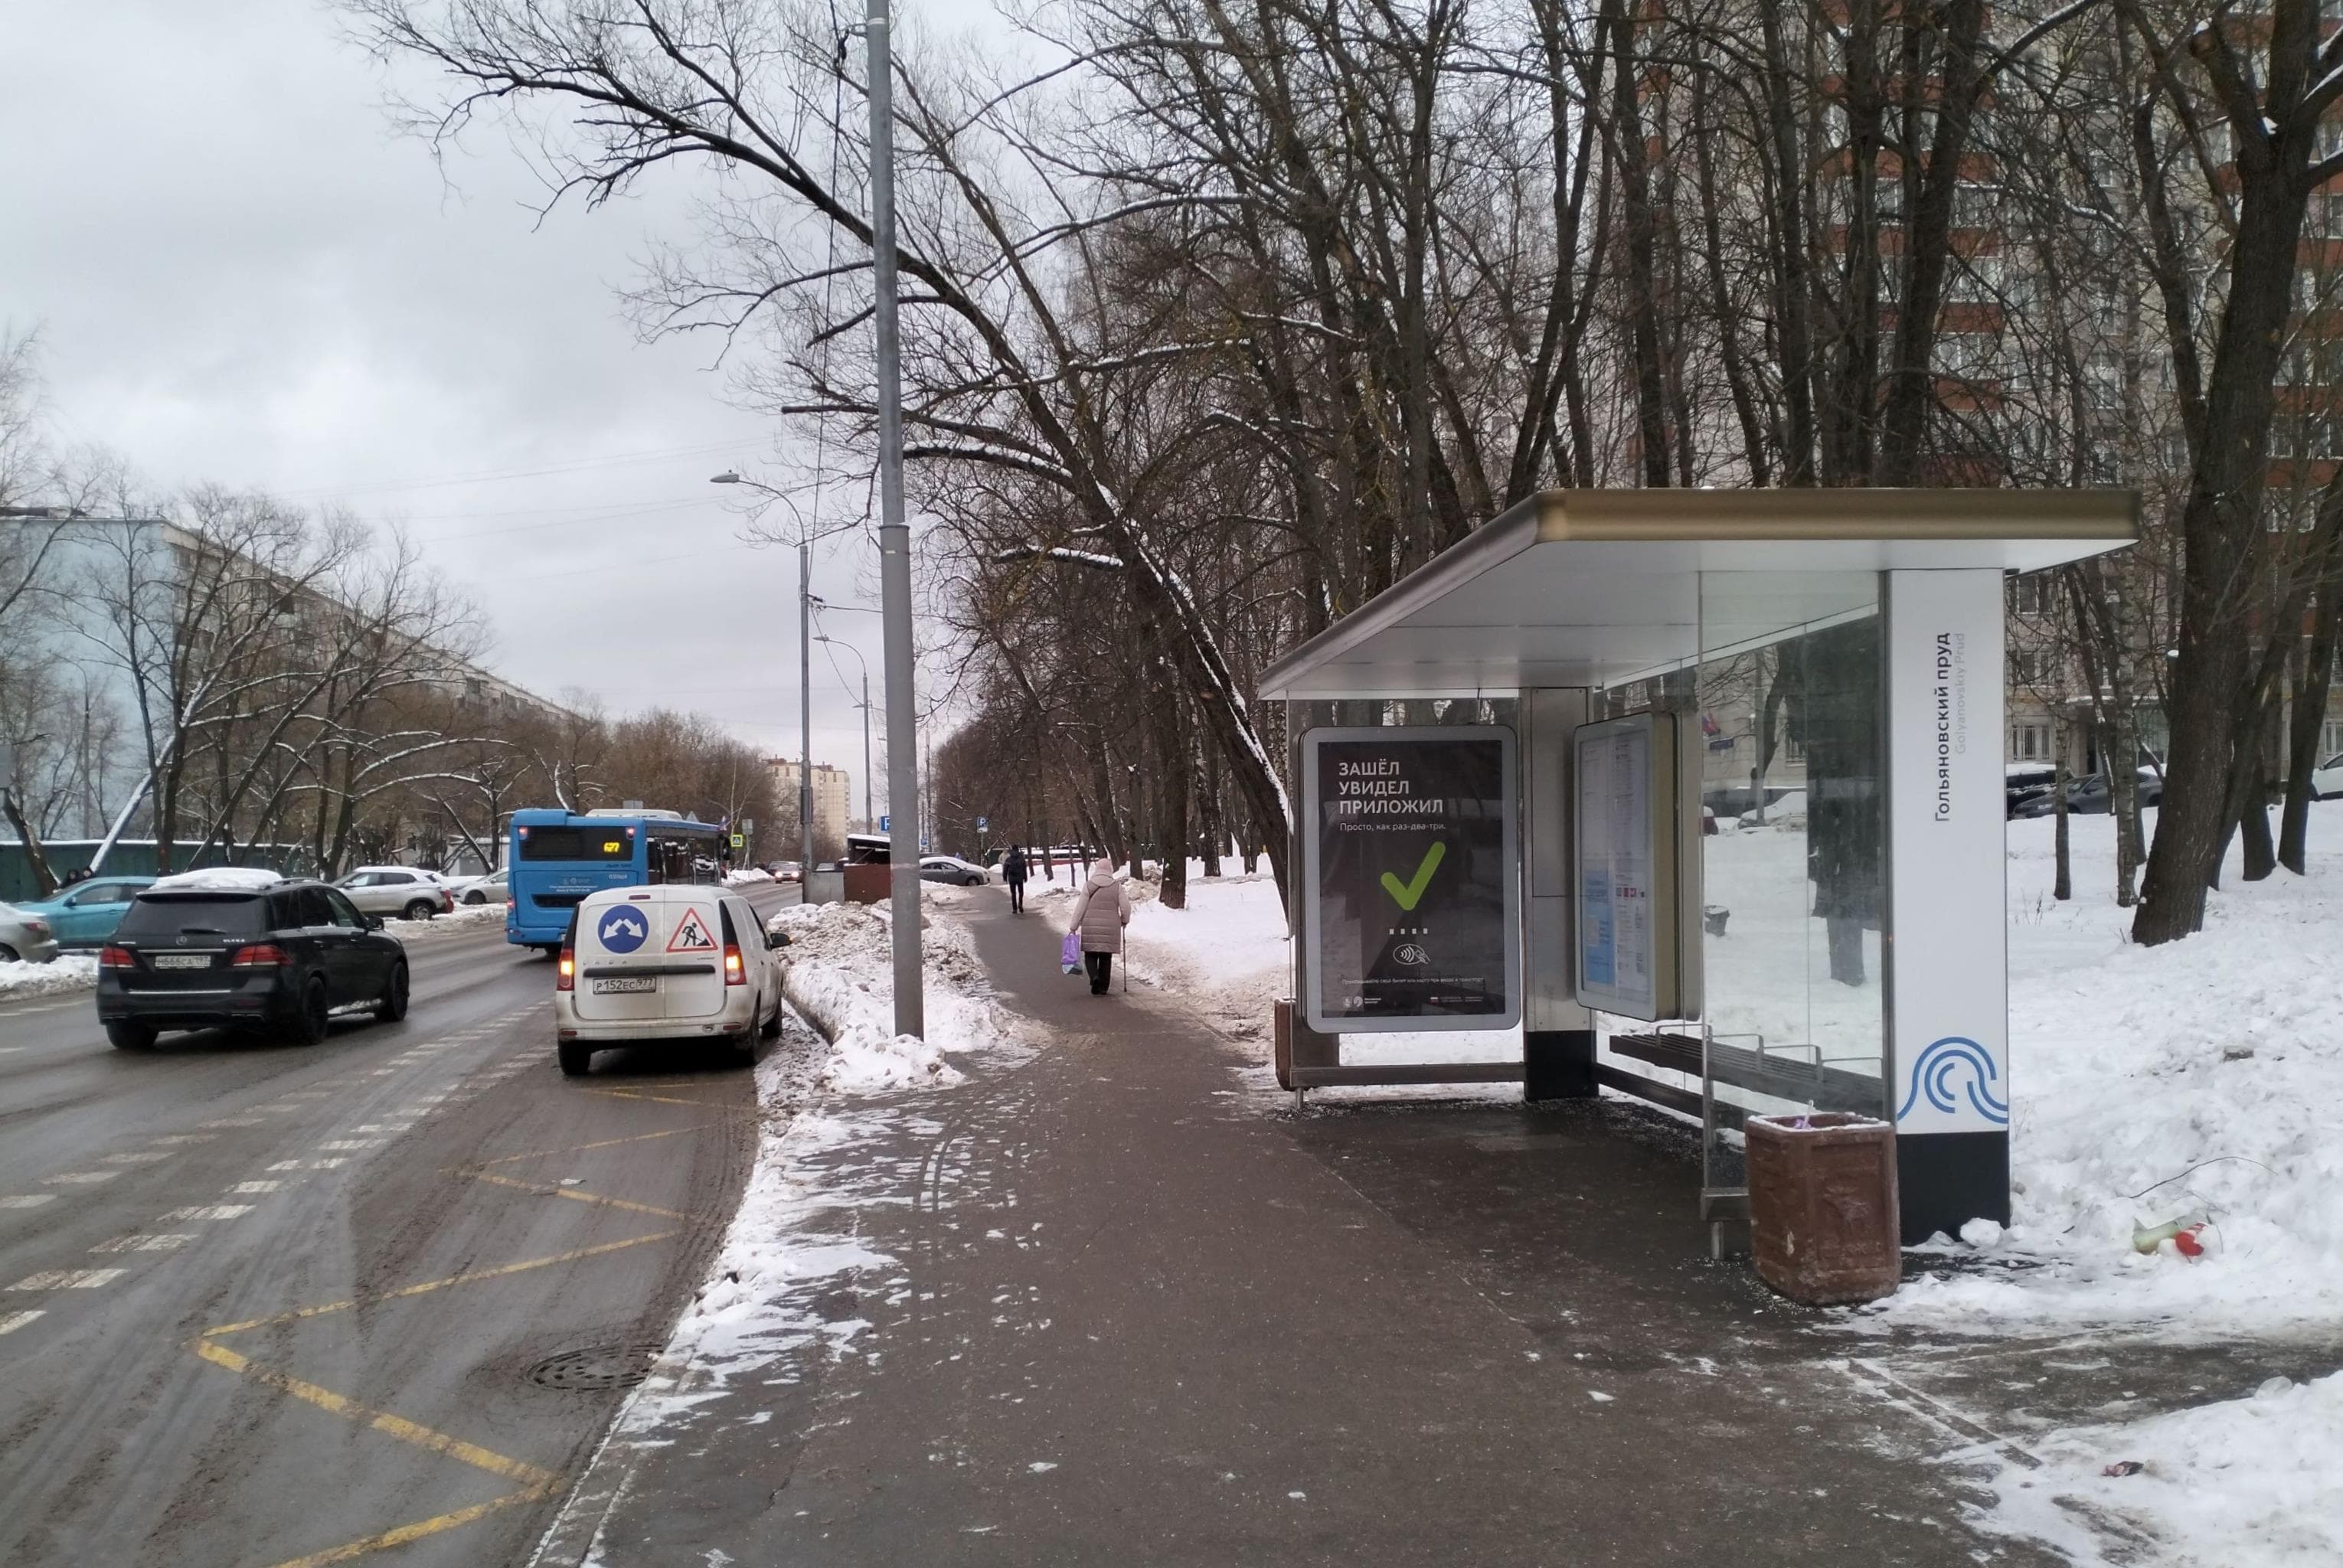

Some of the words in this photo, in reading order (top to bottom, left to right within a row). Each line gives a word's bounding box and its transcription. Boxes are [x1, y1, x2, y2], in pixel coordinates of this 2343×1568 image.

[1936, 632, 1952, 680] пруд
[1953, 632, 1965, 663] Prud
[1954, 667, 1967, 754] Golyanovskiy
[1934, 687, 1950, 822] Гольяновский
[1338, 758, 1400, 776] ЗАШЁЛ
[1338, 780, 1410, 797] УВИДЕЛ
[1339, 799, 1443, 814] ПРИЛОЖИЛ
[1340, 822, 1374, 832] Просто,
[596, 979, 636, 991] Р152ЕС
[636, 978, 653, 987] 977
